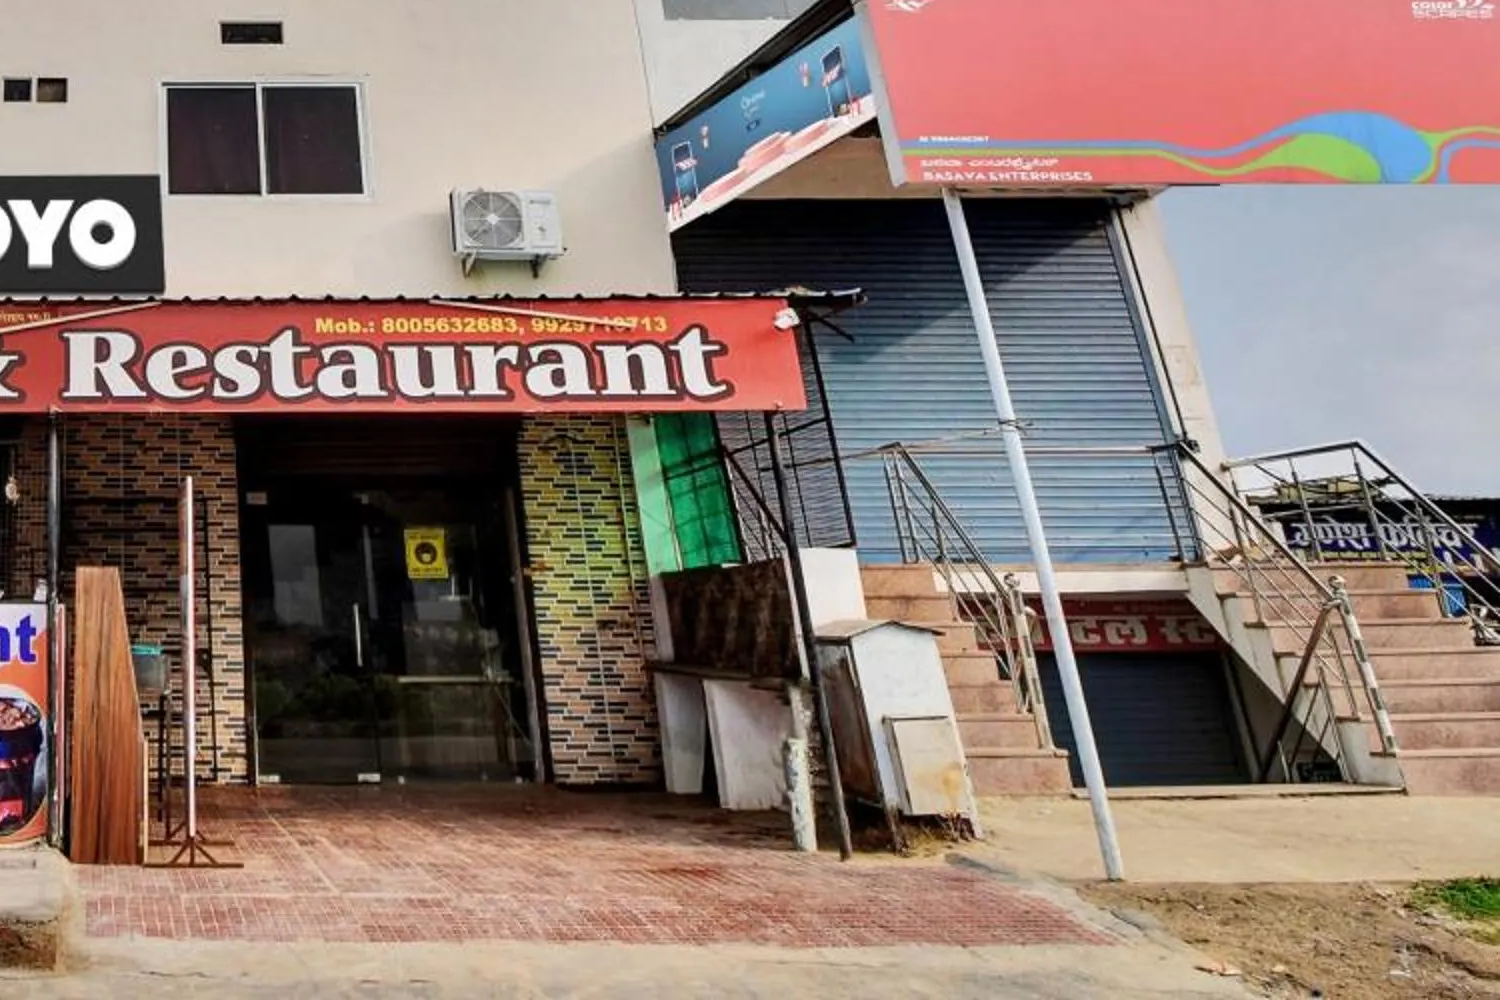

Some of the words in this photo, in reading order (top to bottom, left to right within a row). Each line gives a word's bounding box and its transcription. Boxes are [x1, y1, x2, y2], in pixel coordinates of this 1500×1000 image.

[922, 171, 987, 182] BASAVA
[989, 171, 1093, 182] ENTERPRISES
[314, 317, 375, 334] Mob.:
[59, 325, 732, 400] Restaurant
